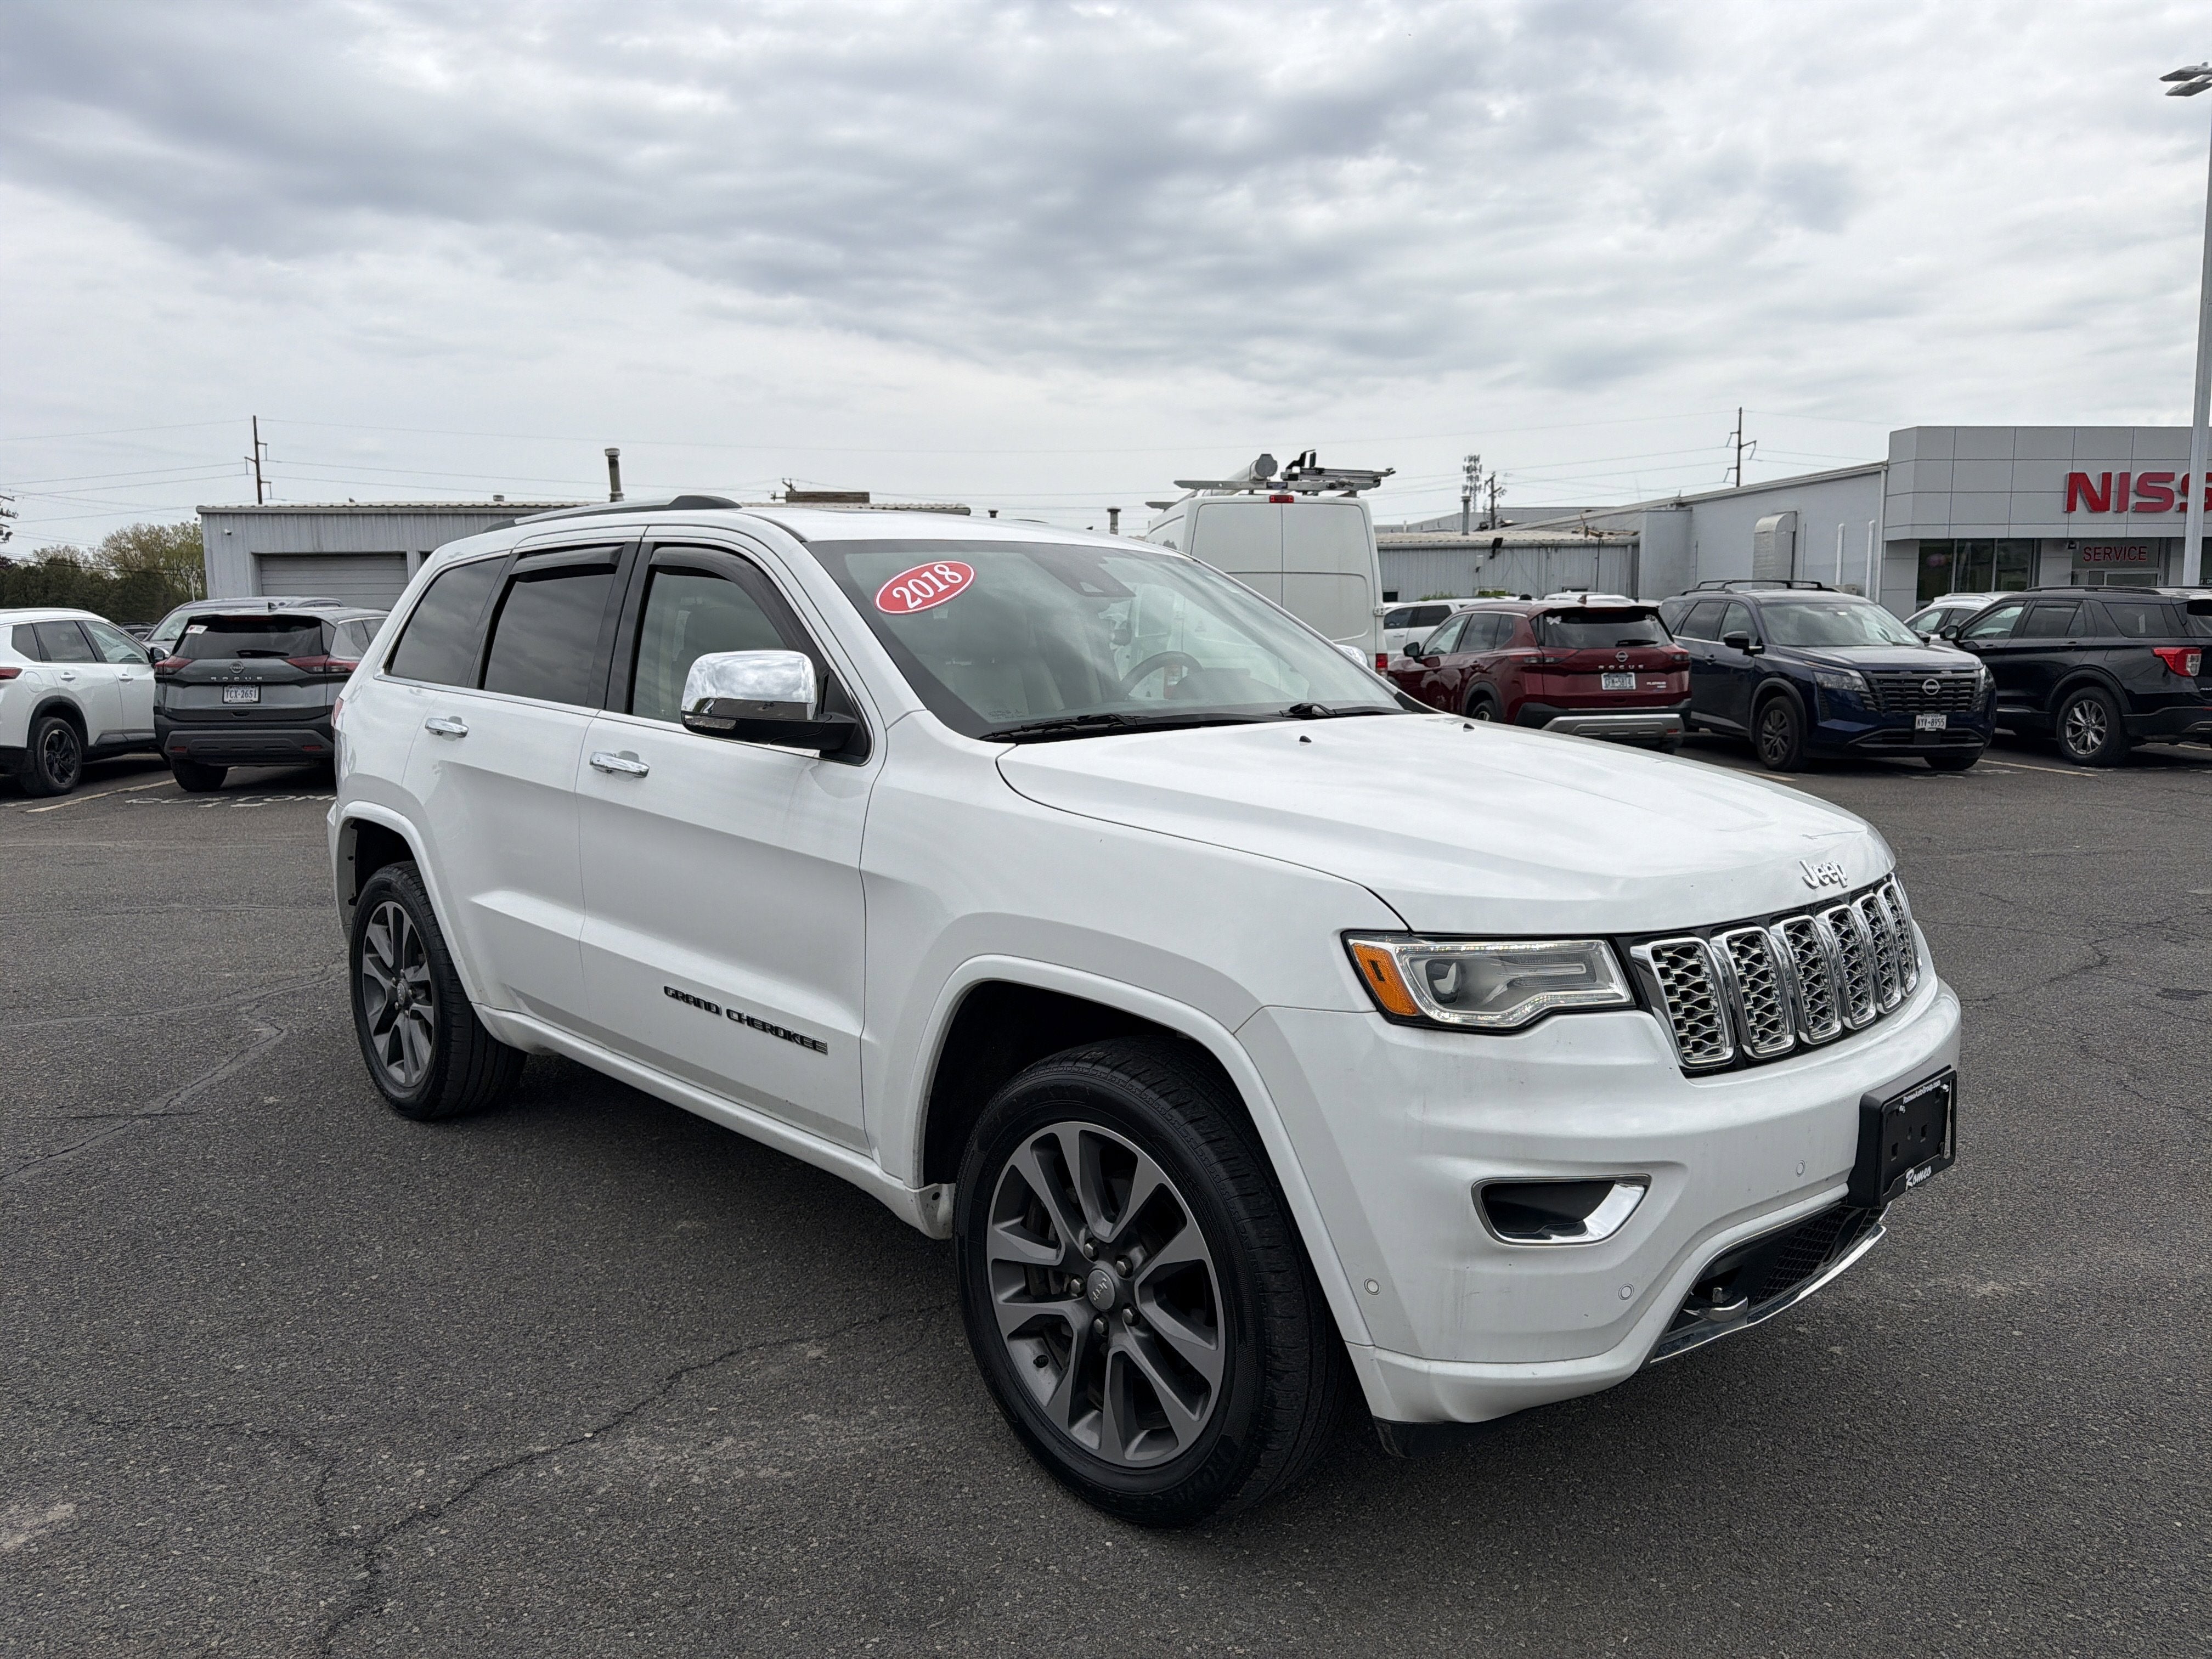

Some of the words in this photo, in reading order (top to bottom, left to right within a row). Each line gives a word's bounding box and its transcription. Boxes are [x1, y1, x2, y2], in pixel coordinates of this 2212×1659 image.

[2083, 546, 2148, 562] SERVICE
[892, 564, 963, 609] 2018
[1799, 860, 1848, 889] Jeep
[663, 985, 722, 1016] GRAND
[726, 1008, 828, 1056] CHEROKEE
